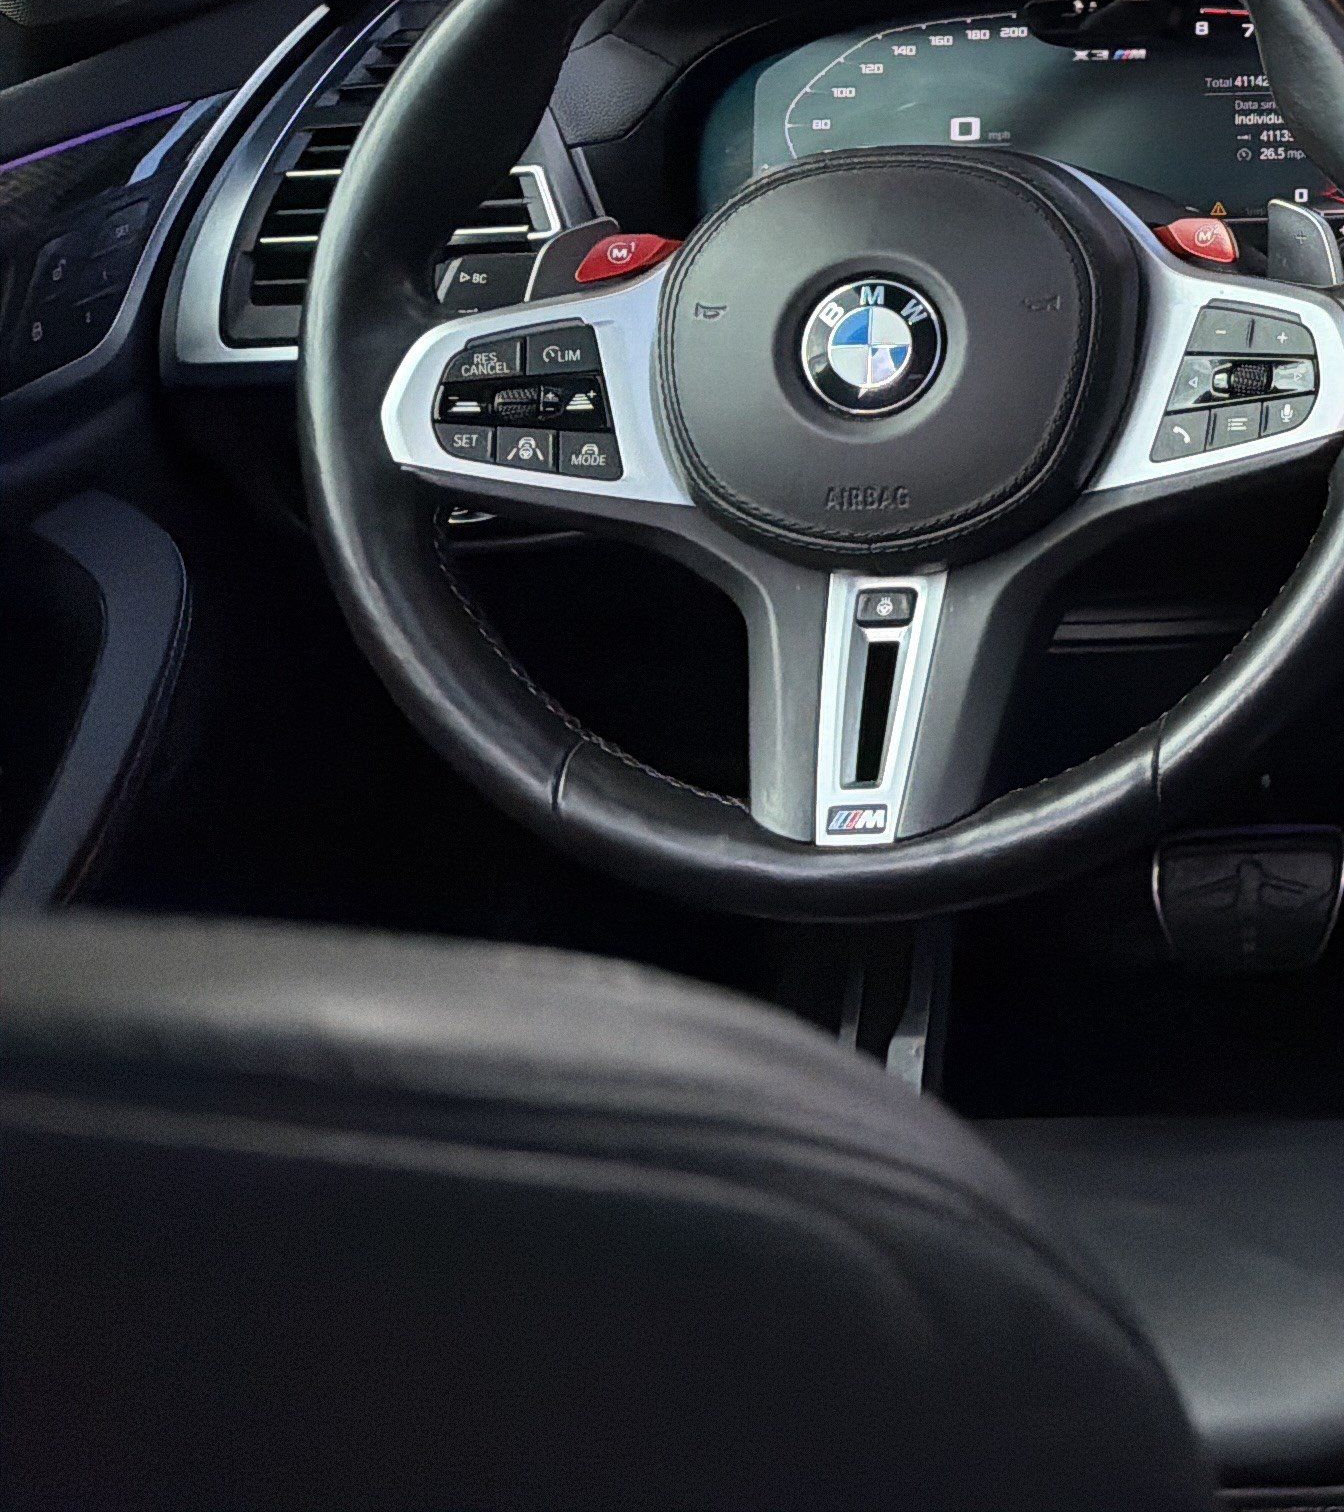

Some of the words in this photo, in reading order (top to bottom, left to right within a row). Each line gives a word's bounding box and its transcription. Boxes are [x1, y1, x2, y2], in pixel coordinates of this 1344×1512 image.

[965, 29, 990, 40] 180
[1000, 27, 1028, 38] 200
[1195, 21, 1210, 36] 8
[1241, 23, 1255, 38] 7
[929, 35, 954, 46] 160
[892, 45, 917, 56] 140
[1072, 49, 1110, 61] X3
[860, 63, 884, 74] 120
[1205, 76, 1233, 88] Total
[1234, 74, 1271, 88] 41142
[832, 87, 856, 98] 100
[1234, 99, 1260, 111] Data
[1261, 100, 1278, 111] sin
[812, 119, 831, 130] 80
[1234, 112, 1285, 126] Individu
[950, 117, 981, 141] 0
[988, 130, 1012, 141] mph
[1260, 147, 1286, 160] 26.5
[1287, 150, 1307, 160] mp
[1294, 188, 1309, 203] 0
[819, 285, 929, 328] BMW
[473, 352, 497, 366] RES
[557, 348, 581, 363] LIM
[461, 361, 511, 377] CANCEL
[453, 434, 479, 448] SET
[570, 454, 607, 467] MODE
[825, 485, 912, 512] AIRBAG
